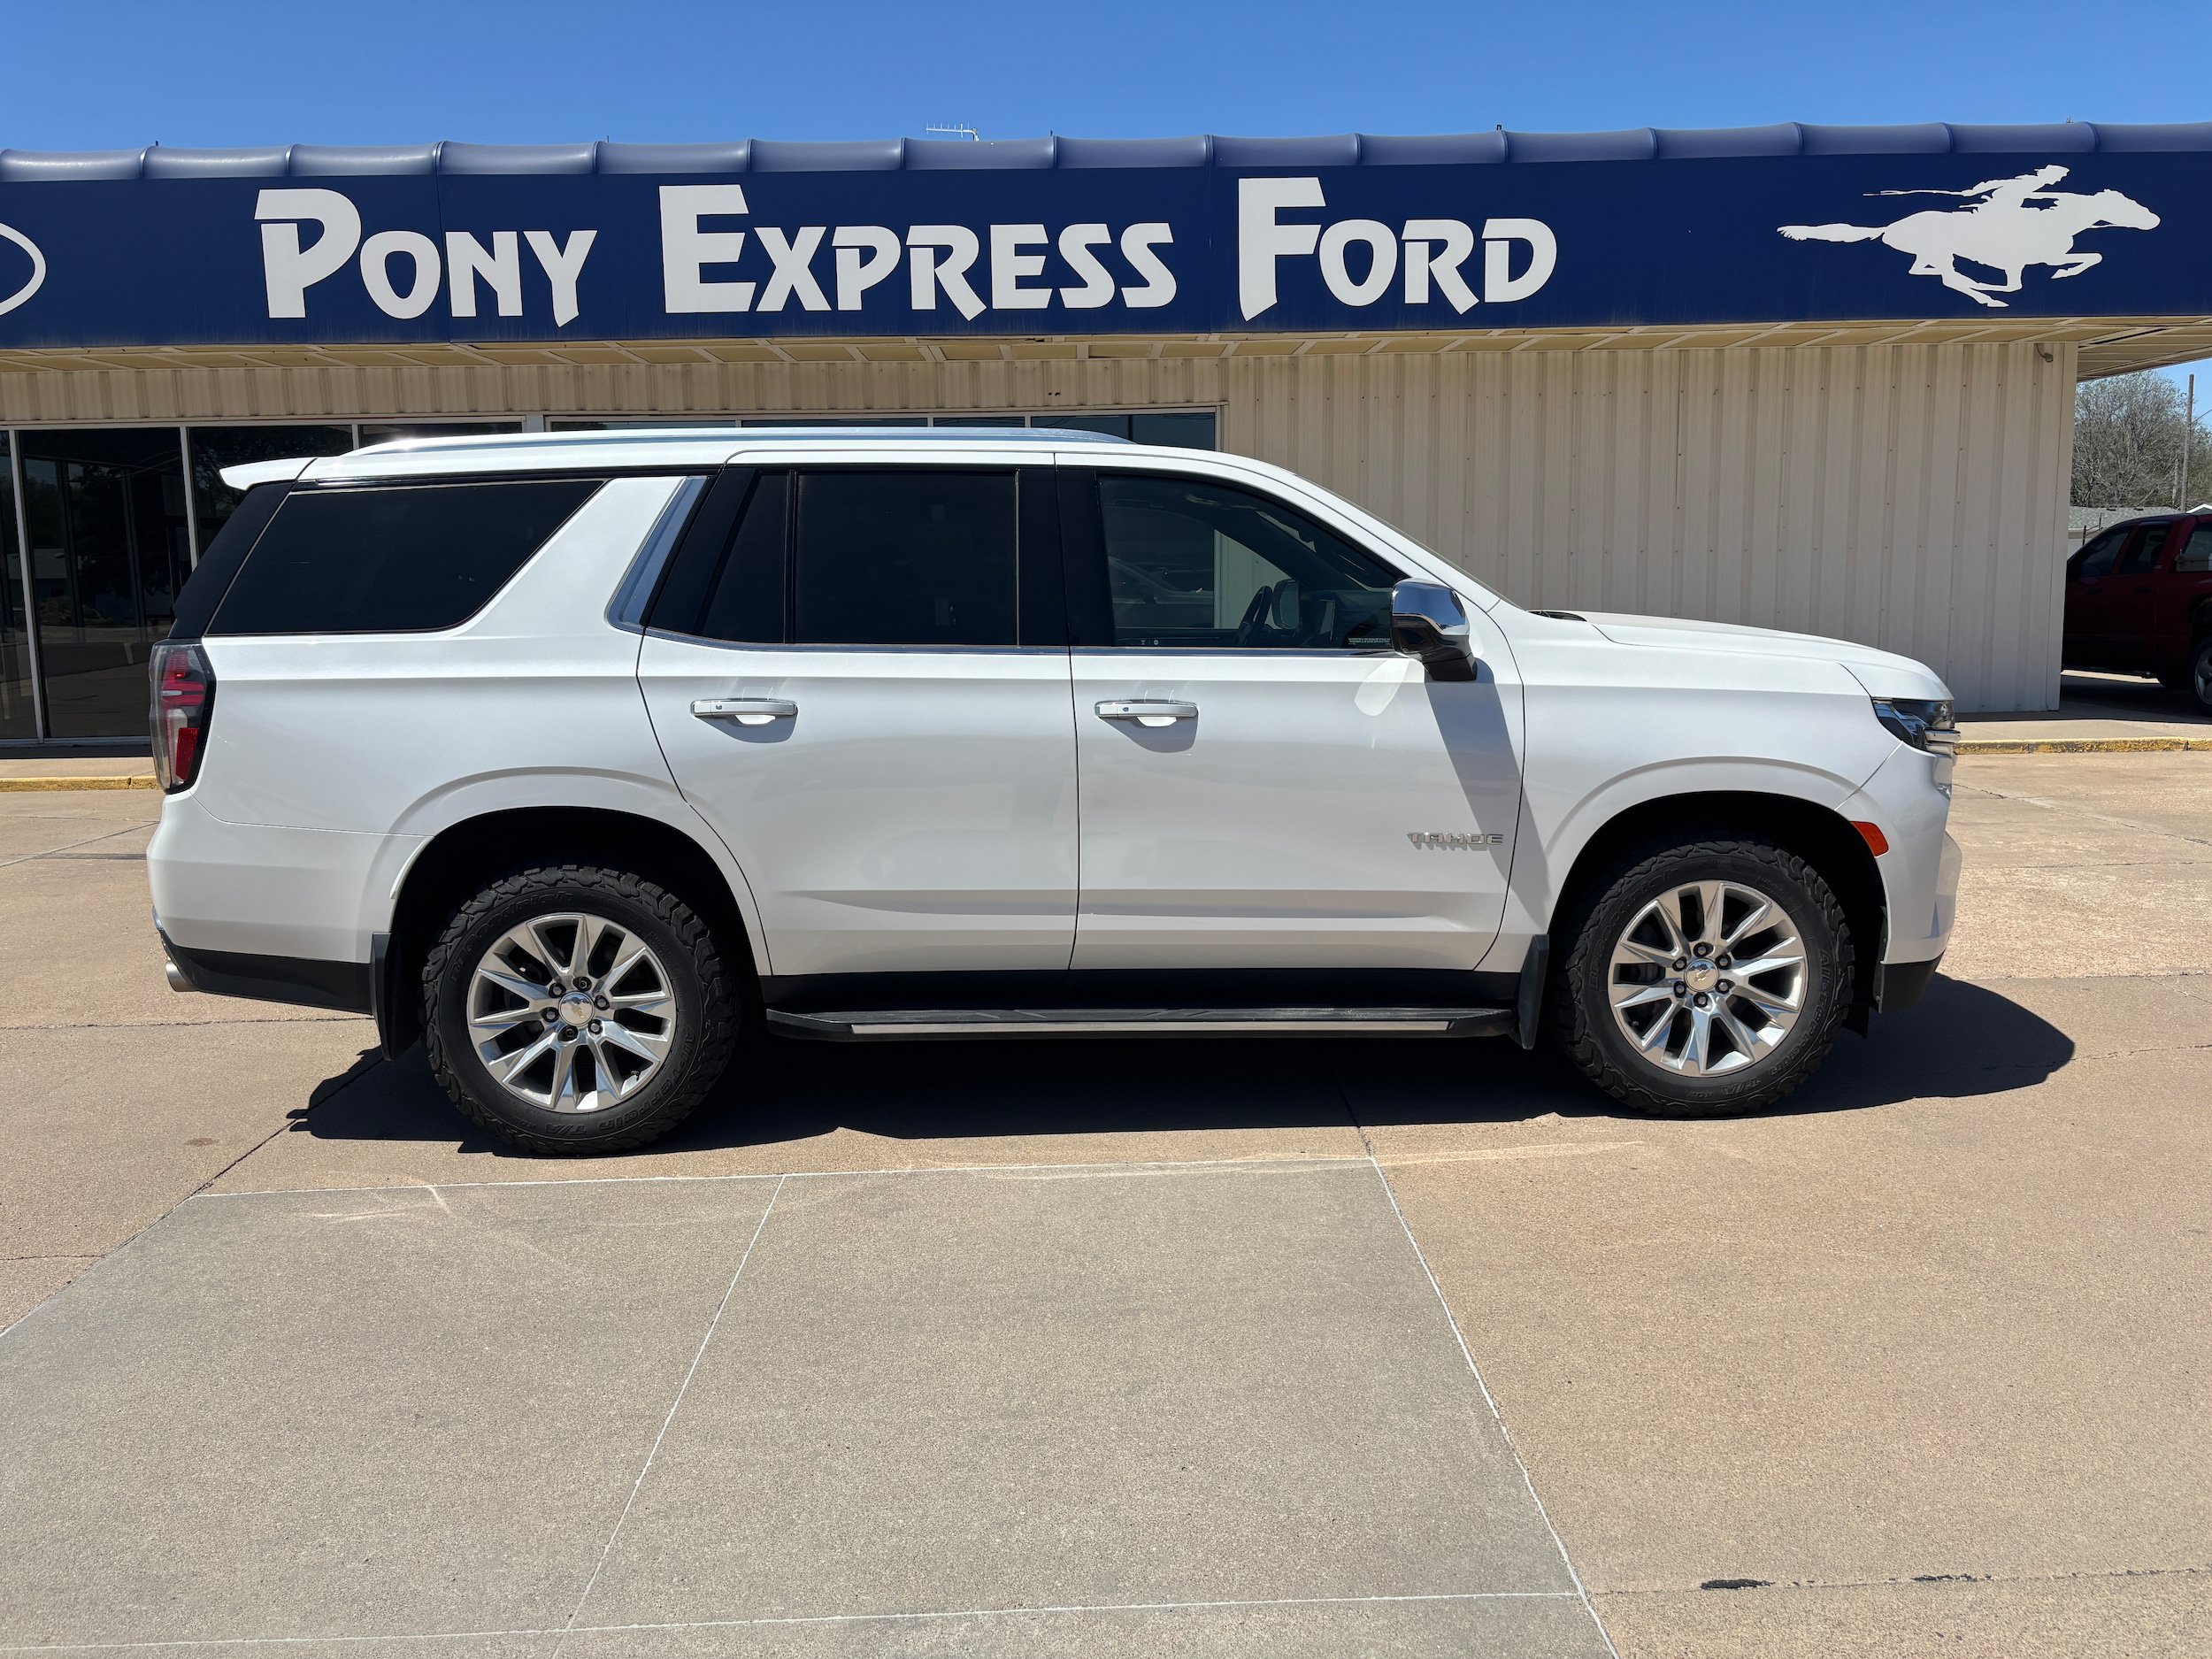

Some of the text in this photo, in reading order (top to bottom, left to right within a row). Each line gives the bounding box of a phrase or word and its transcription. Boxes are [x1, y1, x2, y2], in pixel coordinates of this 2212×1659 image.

[255, 174, 1556, 326] PONY EXPRESS FORD
[1407, 833, 1503, 845] TAHOE
